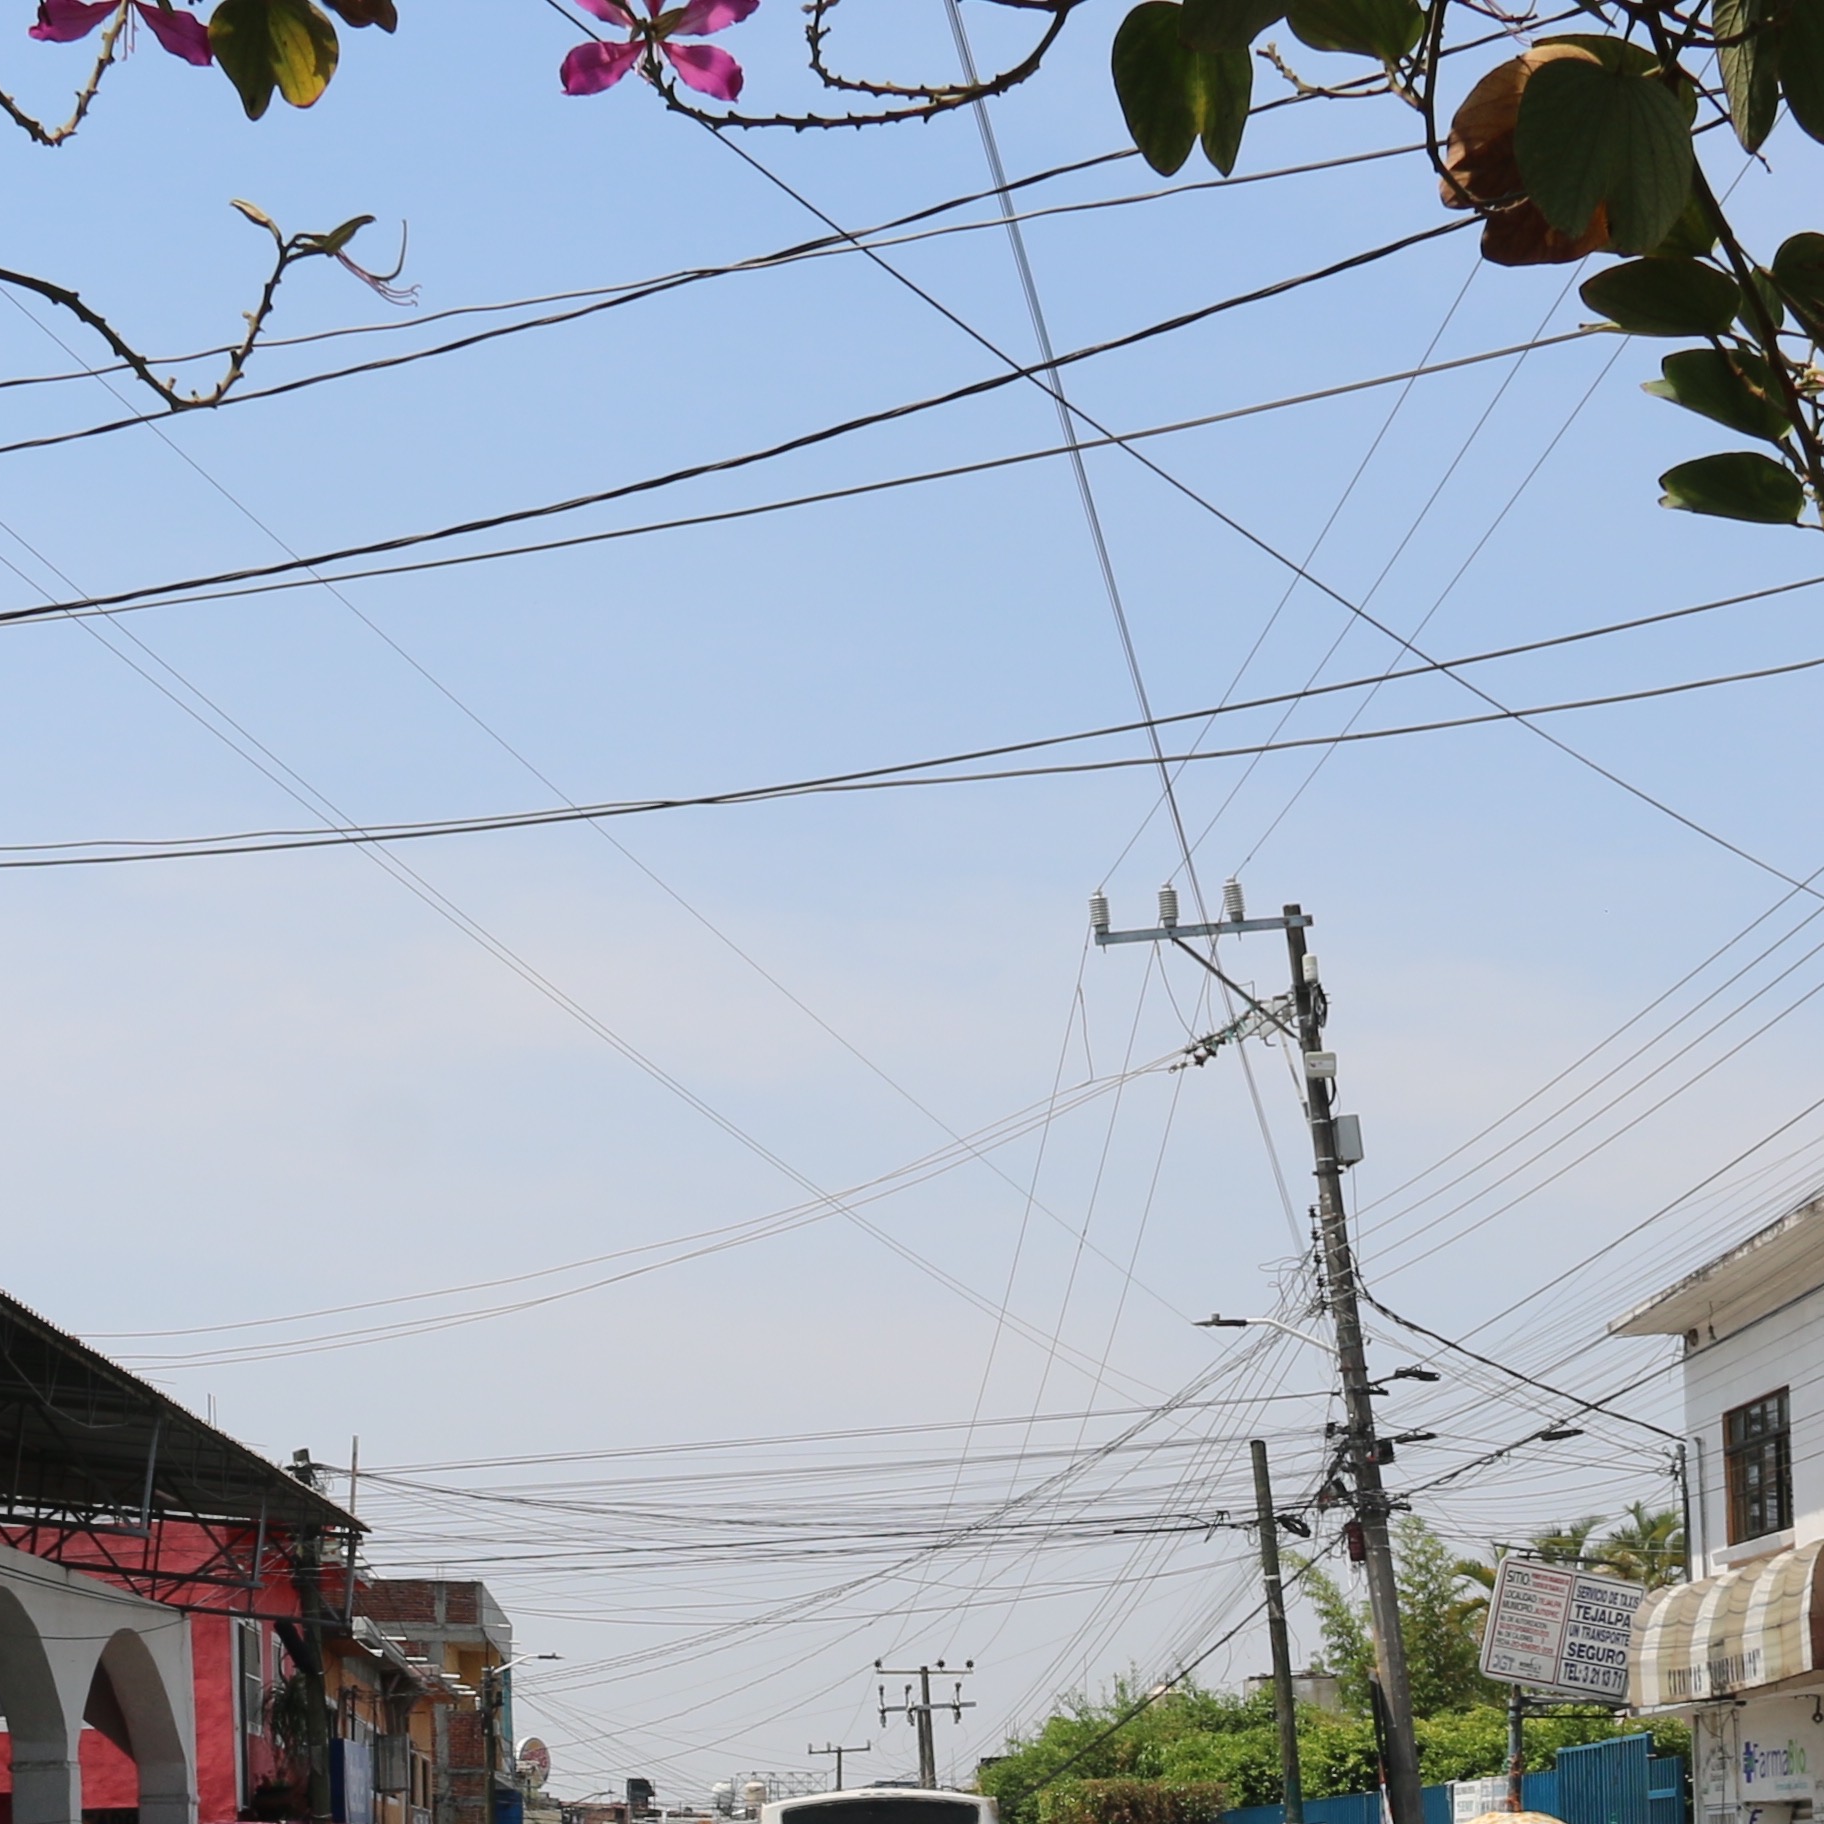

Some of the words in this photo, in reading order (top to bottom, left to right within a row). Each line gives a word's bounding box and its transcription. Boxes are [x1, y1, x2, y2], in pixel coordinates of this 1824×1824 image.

[1576, 1584, 1607, 1603] SERVICIO
[1608, 1591, 1619, 1605] DE
[1575, 1603, 1632, 1629] TEJALPA
[1569, 1623, 1580, 1638] UN
[1581, 1625, 1630, 1647] TRANSPORTE
[1567, 1641, 1627, 1666] SEGURO
